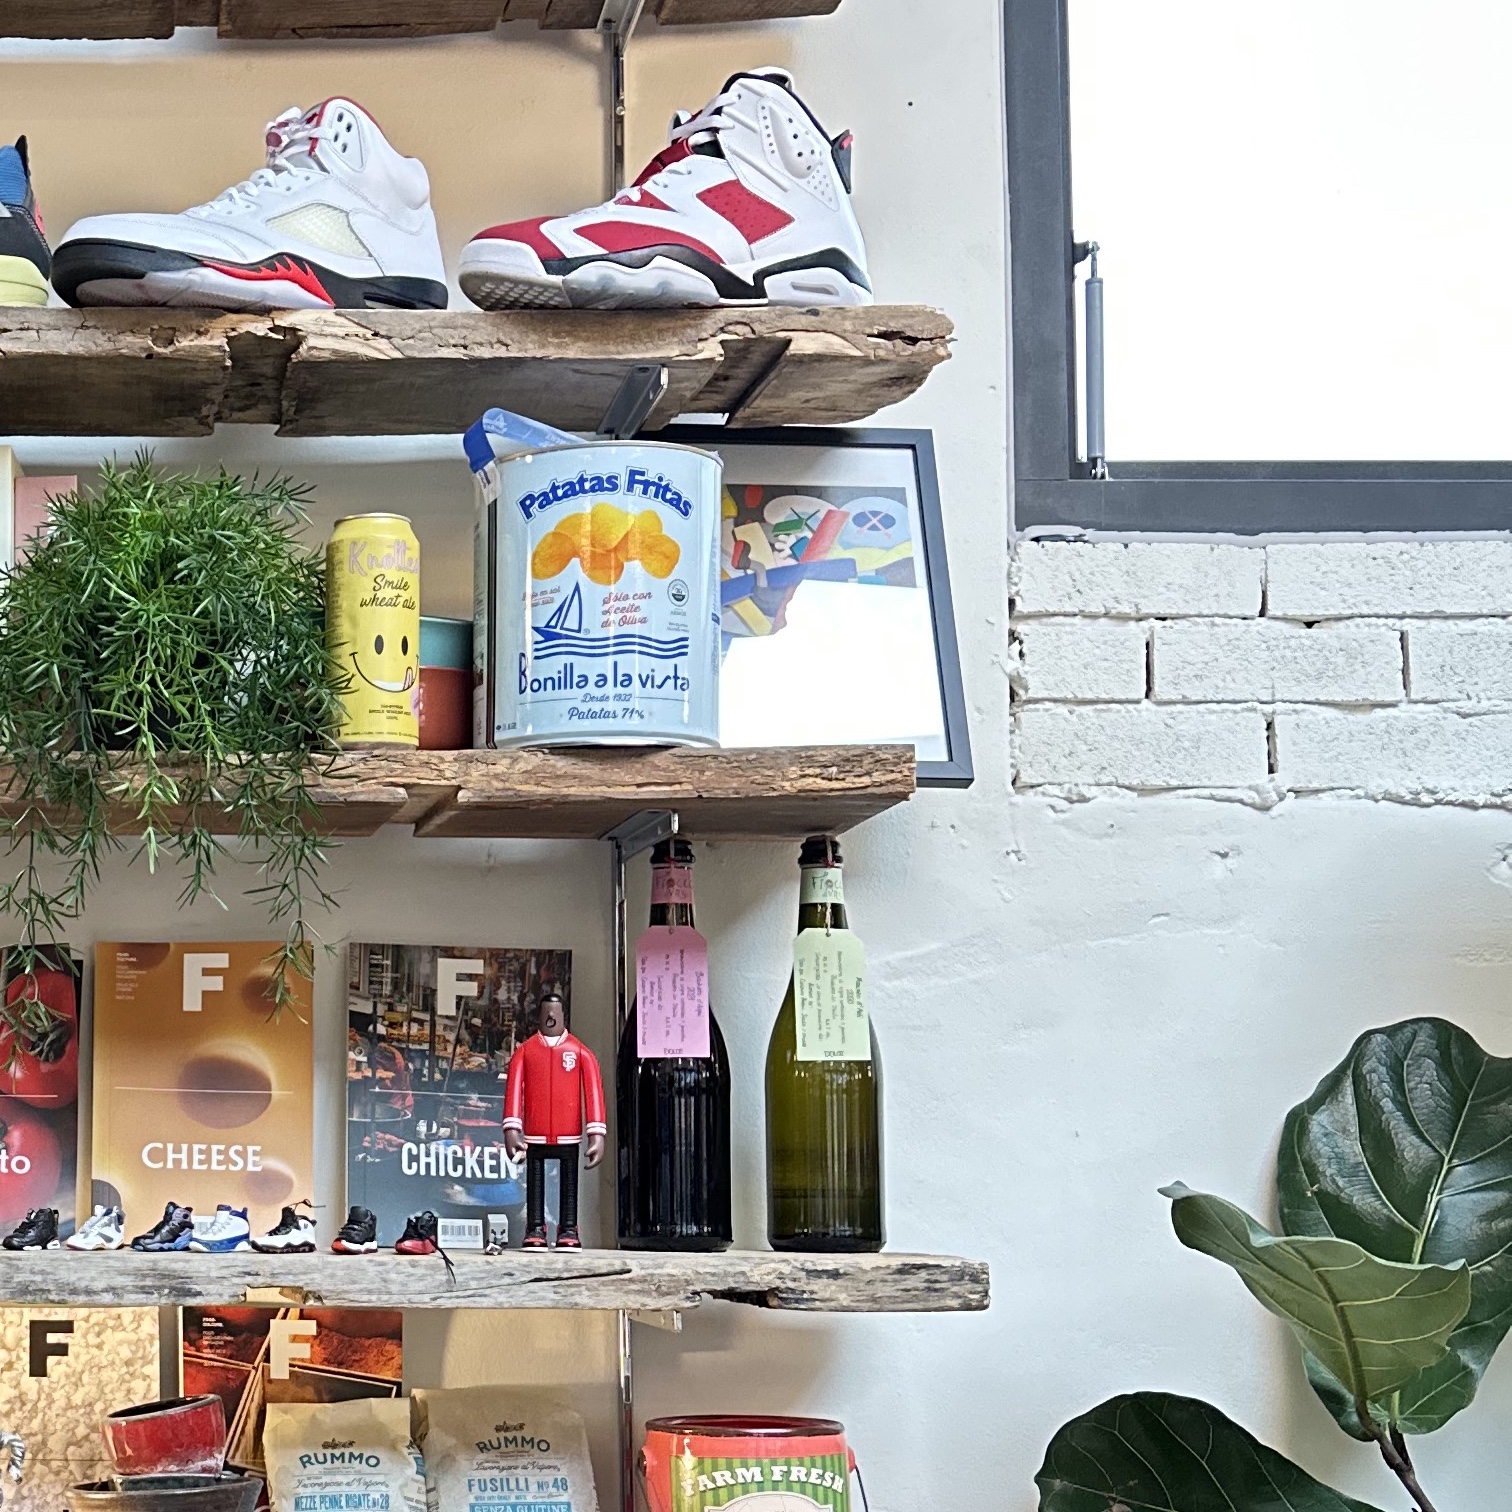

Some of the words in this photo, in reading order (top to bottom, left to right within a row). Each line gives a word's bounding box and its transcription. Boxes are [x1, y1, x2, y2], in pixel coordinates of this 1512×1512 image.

[517, 471, 621, 521] Patatas
[625, 467, 694, 519] Fritas
[372, 573, 410, 592] Smile
[359, 593, 402, 608] wheat
[402, 596, 416, 610] ale
[632, 592, 652, 601] con
[518, 652, 589, 695] Bonilla
[594, 673, 608, 688] a
[613, 661, 632, 688] la
[638, 663, 690, 692] vista
[581, 692, 611, 703] Desde
[567, 706, 618, 720] Patatas
[621, 707, 645, 720] 71%
[183, 953, 229, 1012] F
[437, 957, 484, 1016] F
[141, 1142, 263, 1172] CHEESE
[401, 1142, 518, 1180] CHICKEN
[29, 1319, 74, 1377] F
[270, 1319, 317, 1380] F
[475, 1435, 551, 1454] RUMMO
[298, 1451, 381, 1469] RUMMO
[467, 1477, 530, 1493] FUSILLI
[552, 1477, 568, 1492] 48
[681, 1466, 764, 1497] FARM
[771, 1465, 844, 1494] FRESH
[294, 1494, 317, 1511] MEZZE
[319, 1494, 344, 1511] PENNE
[345, 1493, 371, 1510] RIGATE
